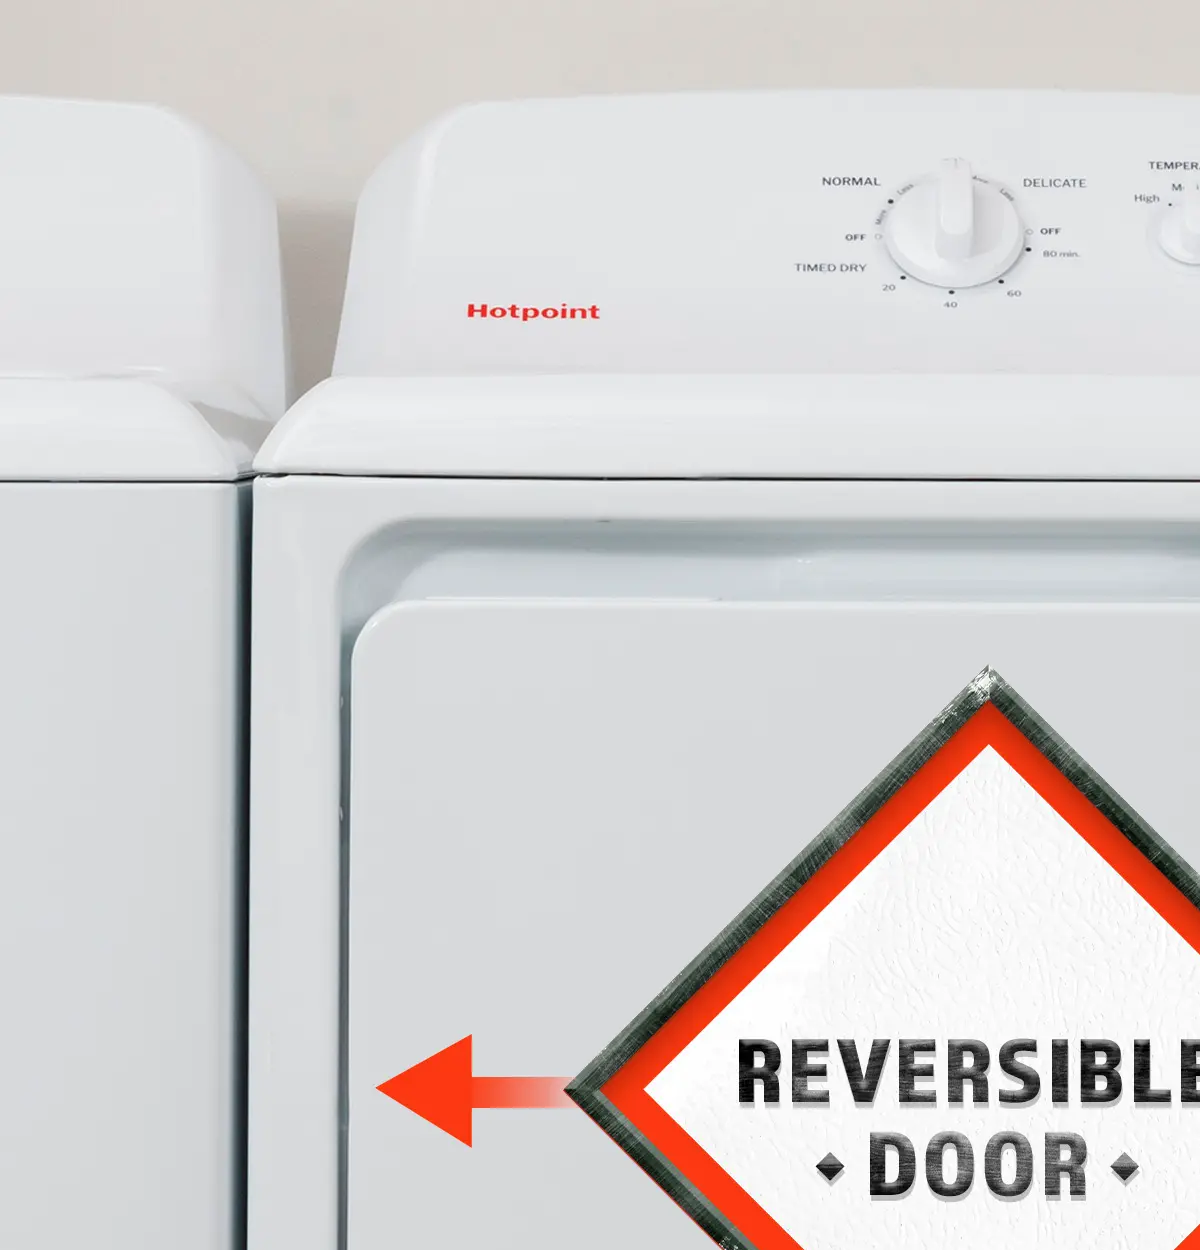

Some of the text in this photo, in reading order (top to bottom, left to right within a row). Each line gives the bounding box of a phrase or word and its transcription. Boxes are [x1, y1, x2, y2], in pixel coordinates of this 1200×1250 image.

[821, 176, 881, 186] NORMAL
[1023, 178, 1087, 188] DELICATE
[1134, 194, 1161, 204] High
[1040, 227, 1062, 236] OFF
[844, 233, 867, 242] OFF
[794, 263, 867, 273] TIMED DRY
[882, 283, 897, 292] 20
[1007, 289, 1022, 298] 60
[943, 301, 958, 309] 40
[466, 302, 601, 322] Hotpoint
